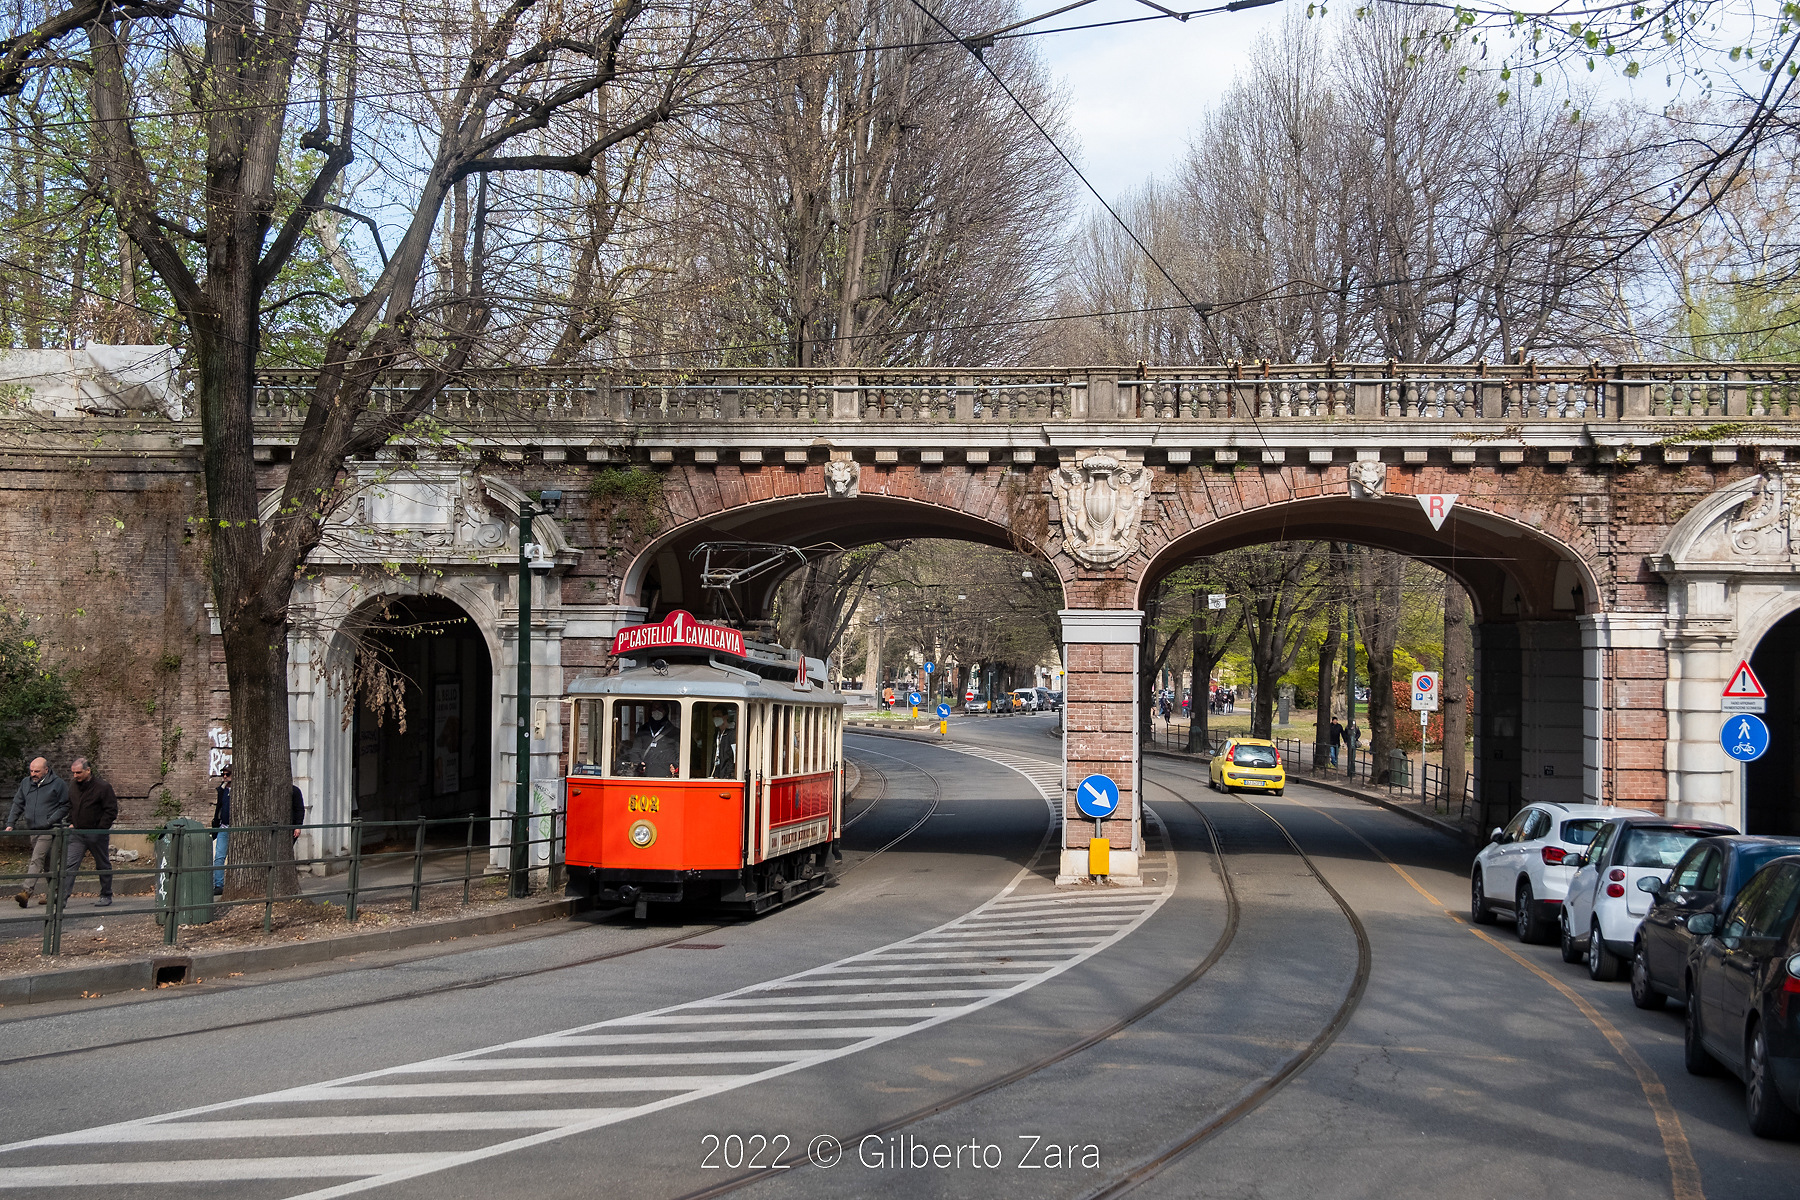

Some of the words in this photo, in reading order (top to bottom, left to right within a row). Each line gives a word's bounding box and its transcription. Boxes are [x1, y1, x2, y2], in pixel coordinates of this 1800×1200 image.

[1430, 496, 1444, 517] R
[630, 626, 672, 647] CASTELLO
[673, 613, 685, 643] 1
[686, 626, 740, 653] CAVALCAVIA
[628, 795, 659, 813] 502
